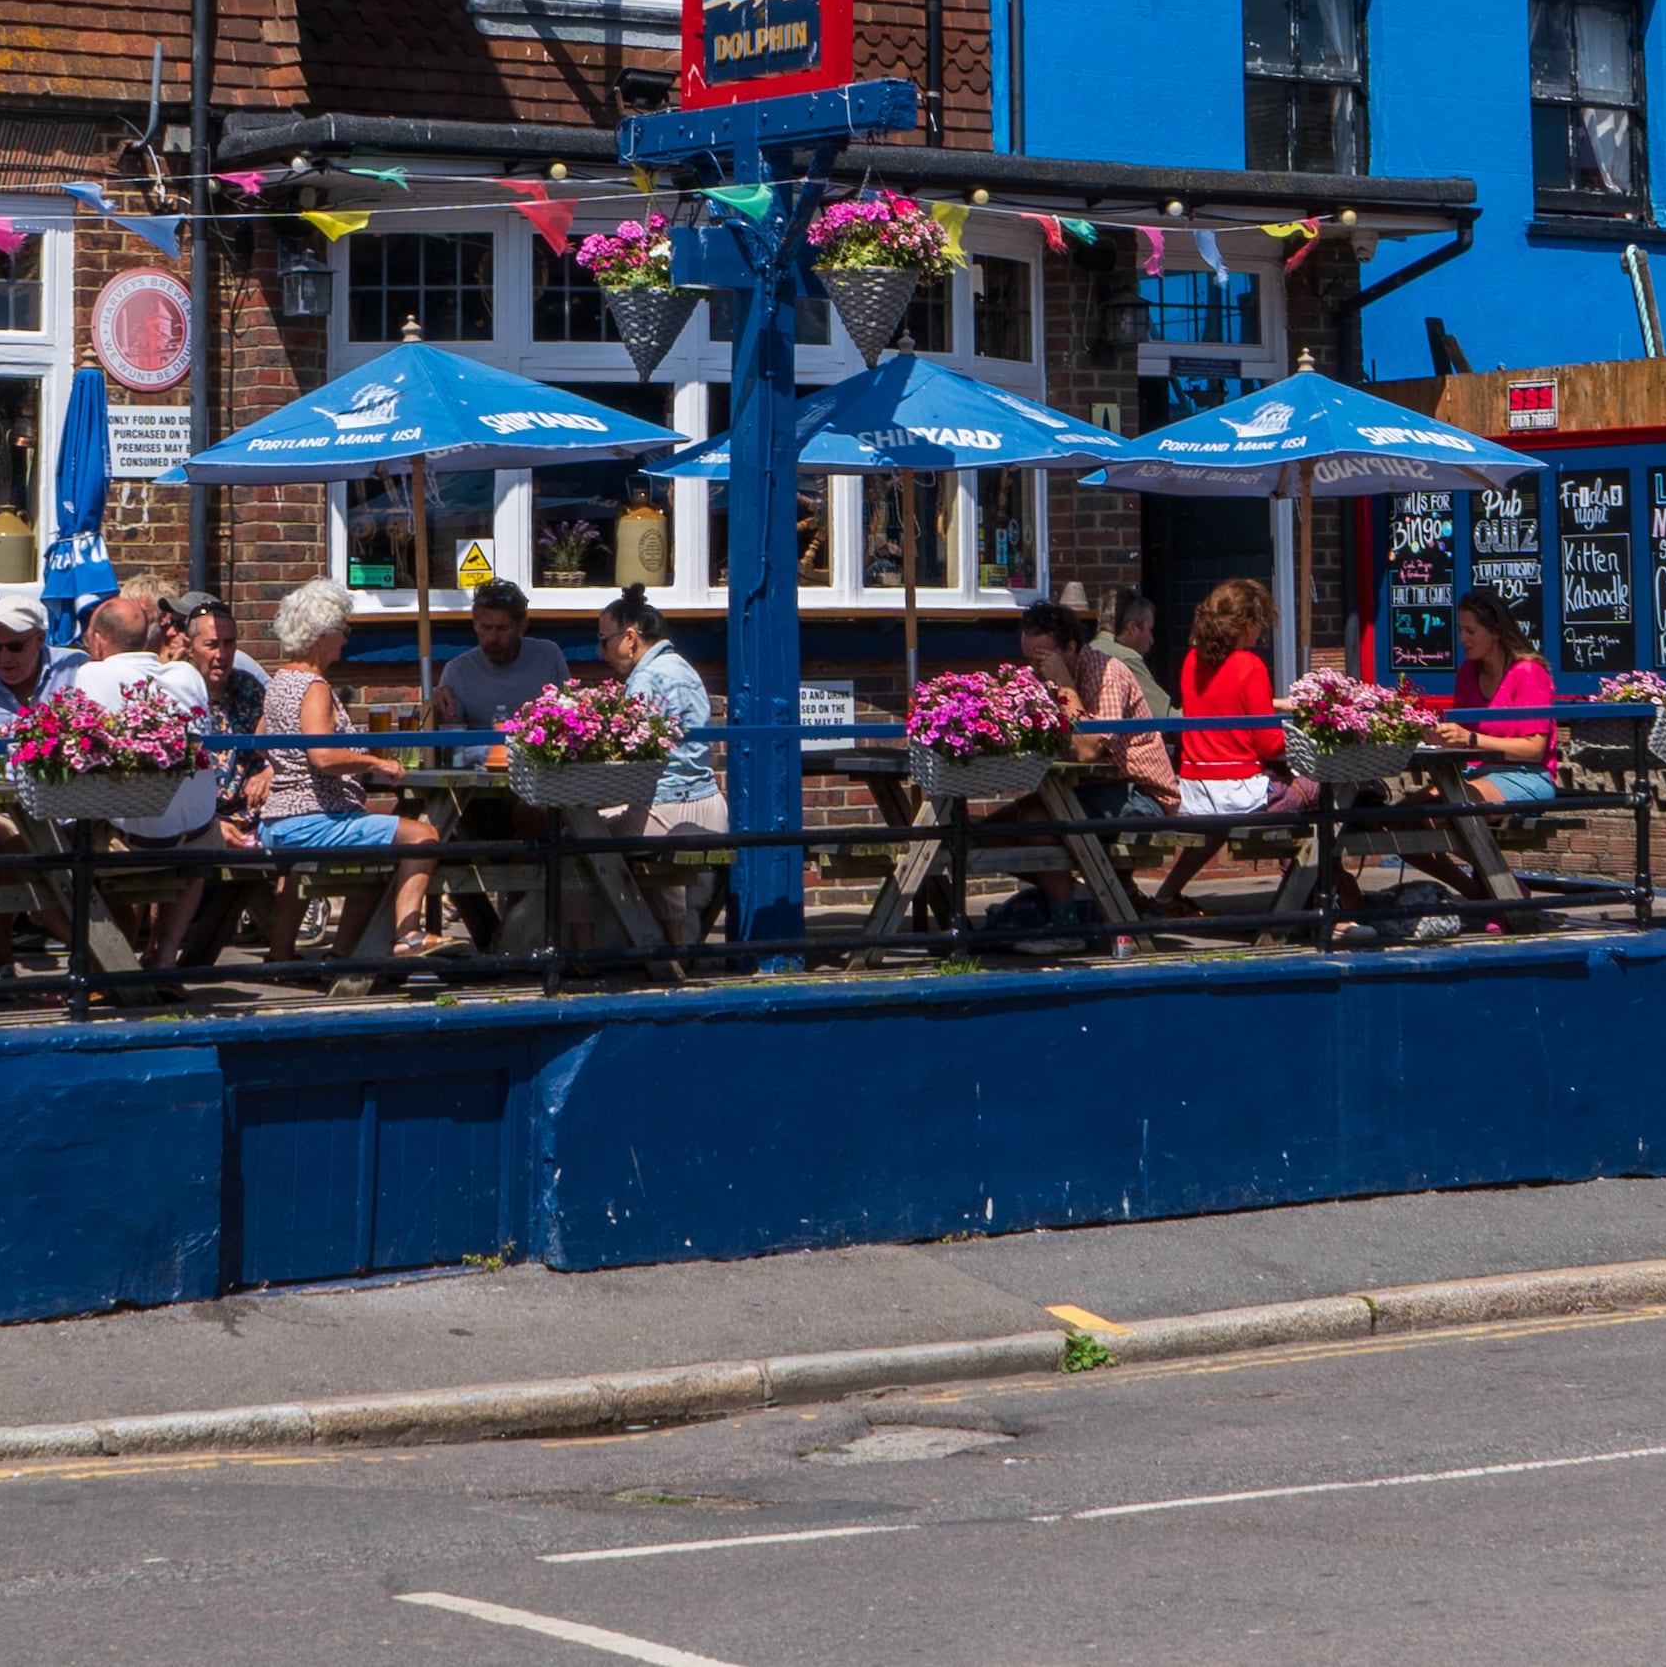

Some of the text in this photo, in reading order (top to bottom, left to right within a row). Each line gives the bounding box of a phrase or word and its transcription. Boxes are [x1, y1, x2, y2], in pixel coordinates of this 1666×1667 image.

[714, 20, 809, 64] DOLPHIN
[150, 277, 192, 323] BREWER
[156, 368, 173, 381] BE
[172, 341, 191, 372] DRU
[108, 416, 129, 425] ONLY
[133, 416, 156, 425] FOOD
[158, 416, 176, 425] AND
[478, 411, 608, 435] SHIPYARD
[114, 430, 166, 439] PURCHASED
[169, 430, 181, 439] ON
[247, 427, 422, 452] PORTLAND MAINE USA
[858, 427, 1003, 451] SHIPYARD
[1158, 435, 1308, 453] PORTLAND MAINE USA
[1357, 426, 1477, 453] SHIPYARD
[117, 443, 161, 452] PREMISES
[164, 444, 183, 452] MAY
[120, 457, 169, 467] CONSUMED
[1431, 494, 1451, 511] FOR
[1482, 488, 1523, 519] Pub
[1574, 506, 1609, 531] night
[1389, 517, 1442, 551] Bingo
[1473, 519, 1539, 554] QUIZ
[1563, 540, 1621, 573] Kitten
[1564, 573, 1630, 613] Kaboodle
[809, 691, 825, 700] AND
[819, 704, 829, 713] ON
[832, 704, 845, 713] THE
